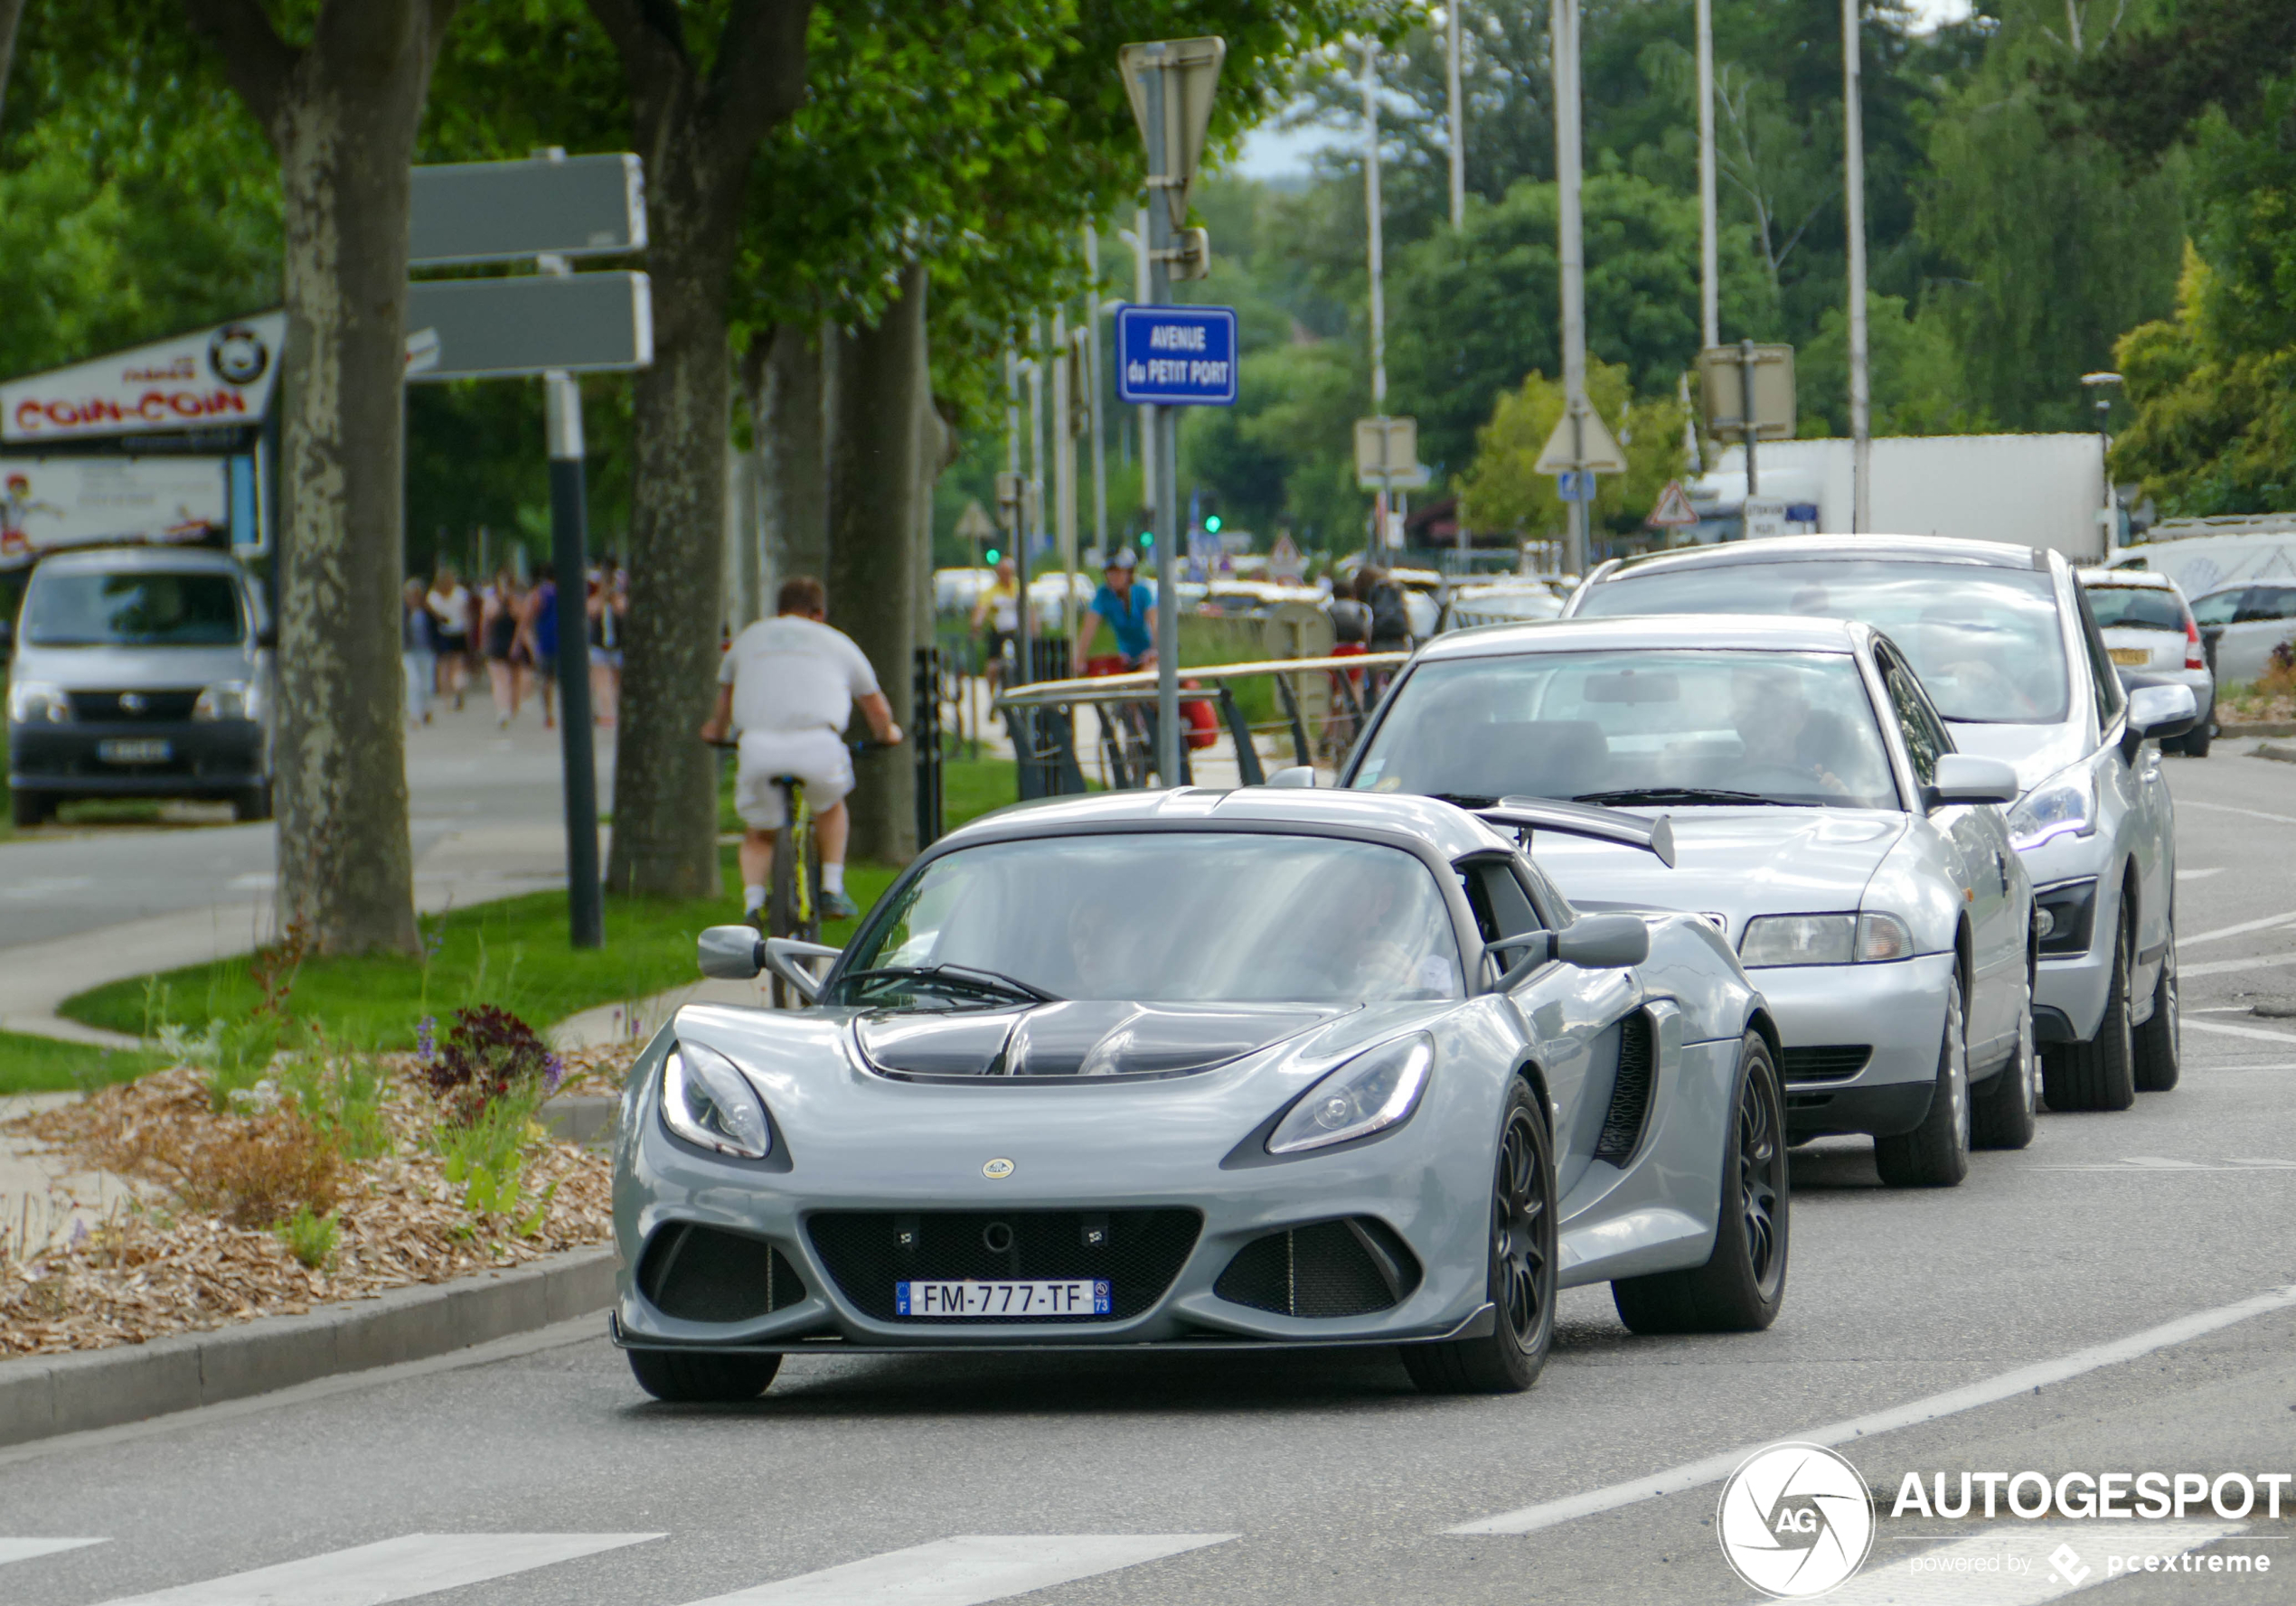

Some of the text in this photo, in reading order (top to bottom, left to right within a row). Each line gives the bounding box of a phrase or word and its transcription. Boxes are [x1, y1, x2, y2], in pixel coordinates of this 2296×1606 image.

[1150, 325, 1206, 351] AVENUE
[1128, 359, 1228, 386] du PETIT PORT
[899, 1301, 907, 1313] F
[924, 1284, 1080, 1312] FM-777-TF
[1096, 1299, 1108, 1311] 73
